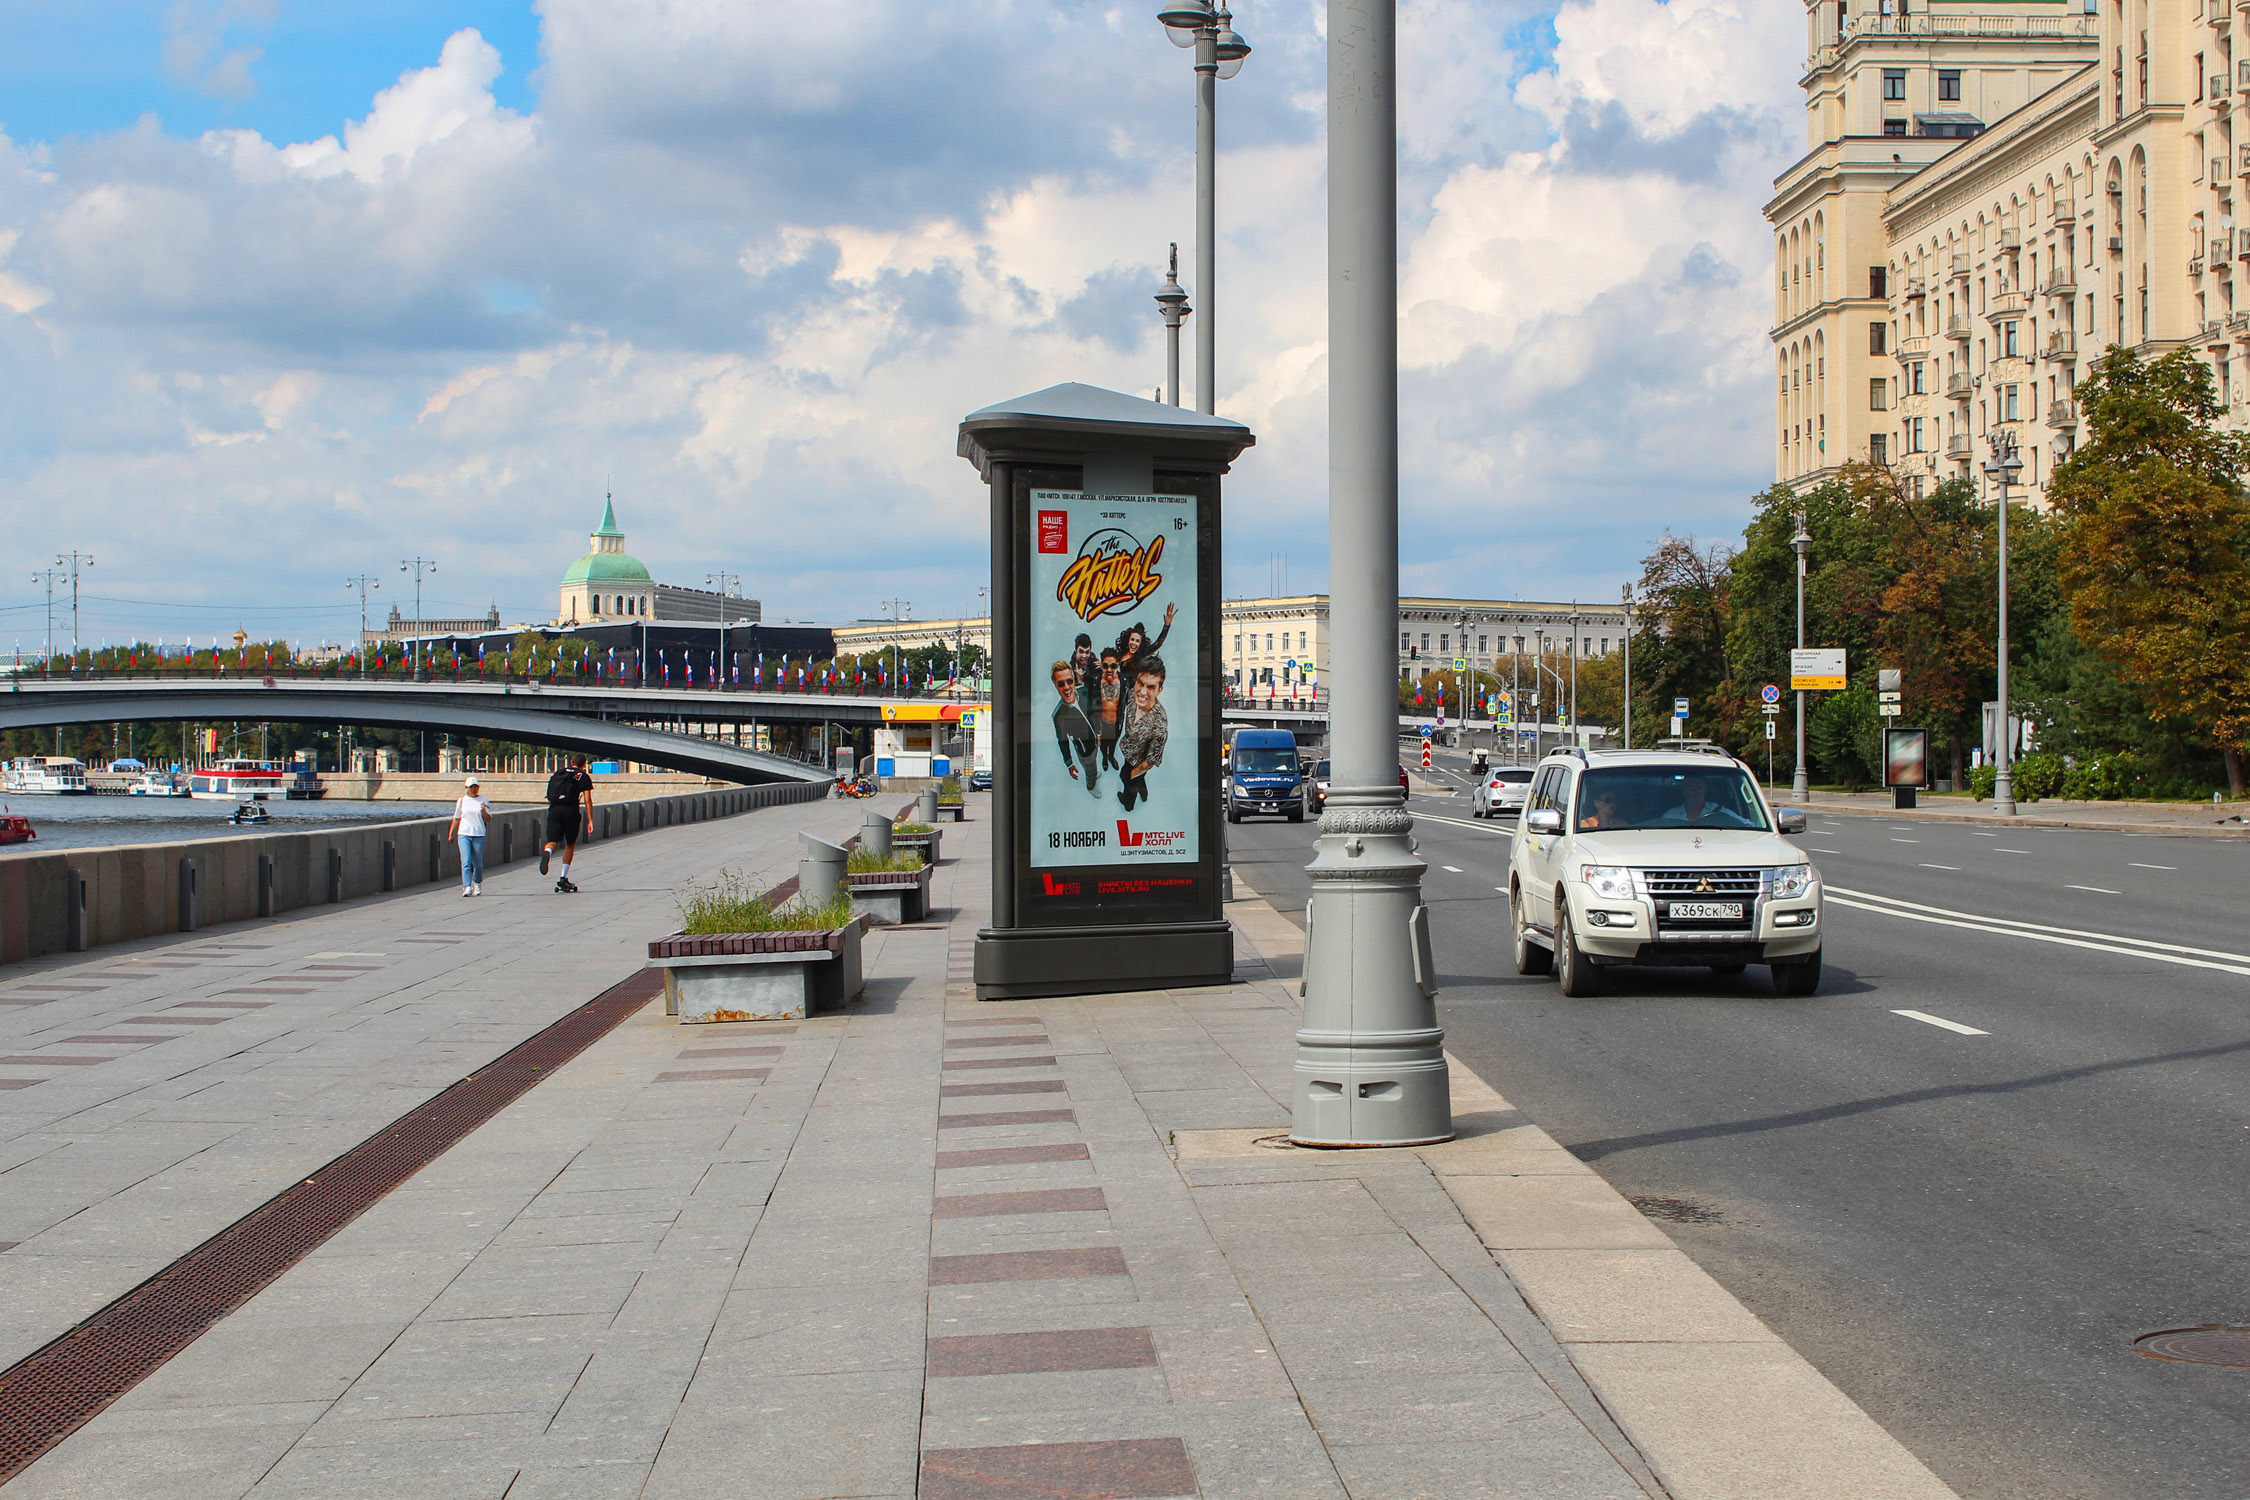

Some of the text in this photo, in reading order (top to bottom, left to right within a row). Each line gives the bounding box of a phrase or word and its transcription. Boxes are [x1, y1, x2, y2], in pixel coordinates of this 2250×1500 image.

[1042, 516, 1063, 525] НАШЕ
[1173, 517, 1188, 531] 16+
[1101, 535, 1124, 554] The
[1048, 831, 1106, 848] 18 НОЯБРЯ
